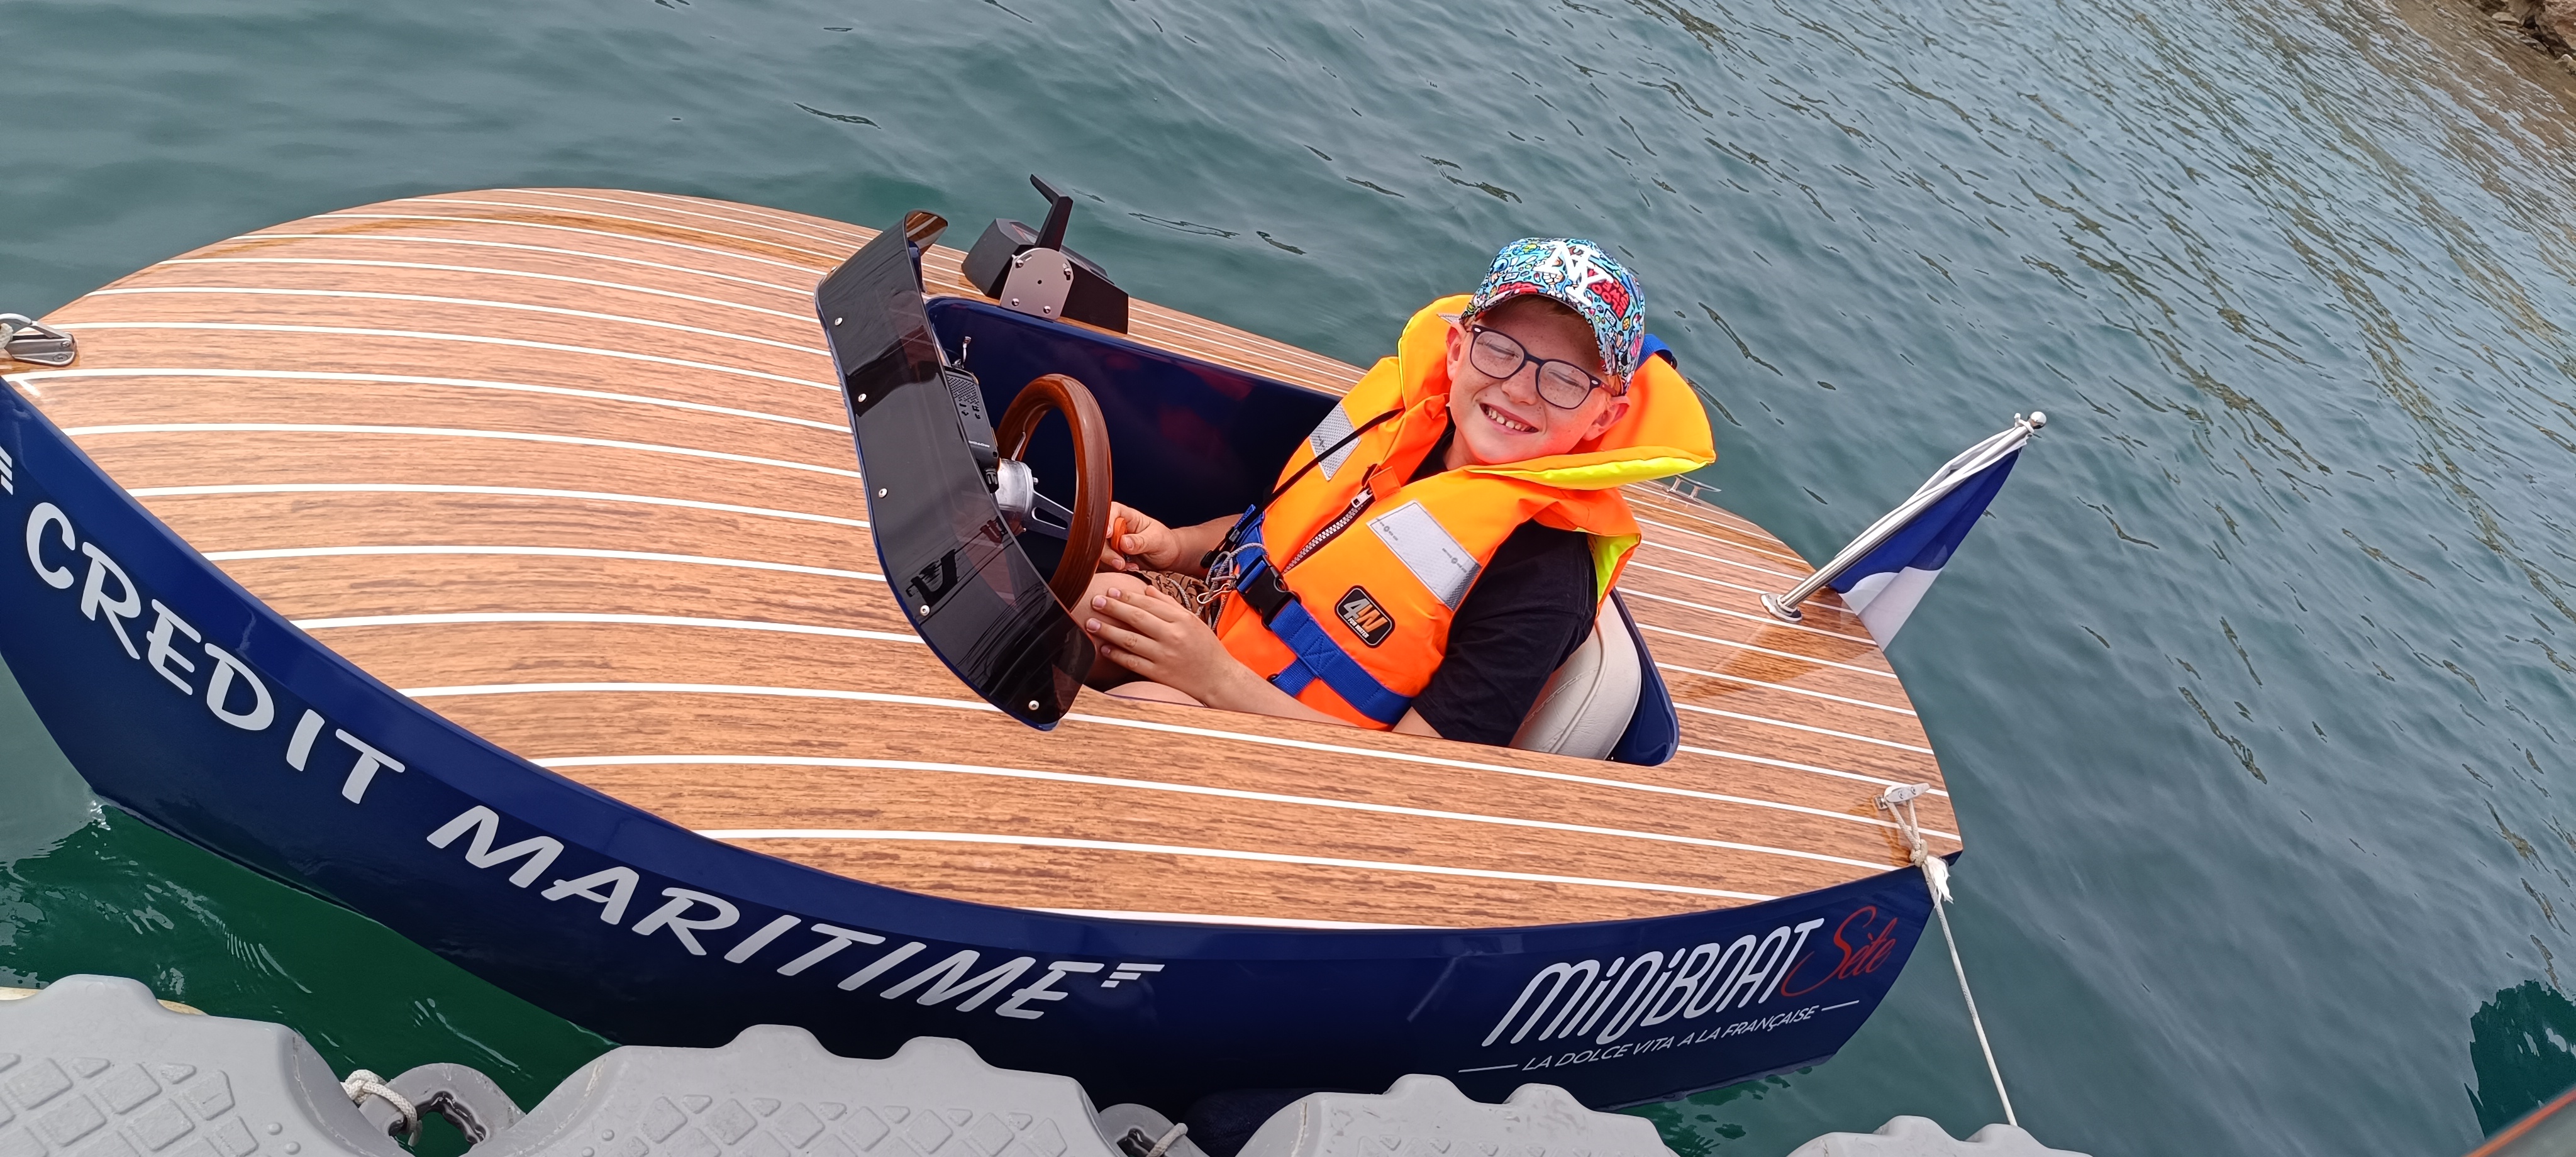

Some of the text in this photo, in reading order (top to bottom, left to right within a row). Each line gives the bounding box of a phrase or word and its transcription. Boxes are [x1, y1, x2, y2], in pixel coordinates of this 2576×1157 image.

[1531, 241, 1614, 307] NY
[1343, 598, 1388, 633] 4W
[1347, 617, 1370, 639] FOR WATER
[26, 502, 1105, 1019] CREDIT MARITIME
[1521, 1005, 1819, 1071] LA DOLCE VITA A LA FRANÇAISE
